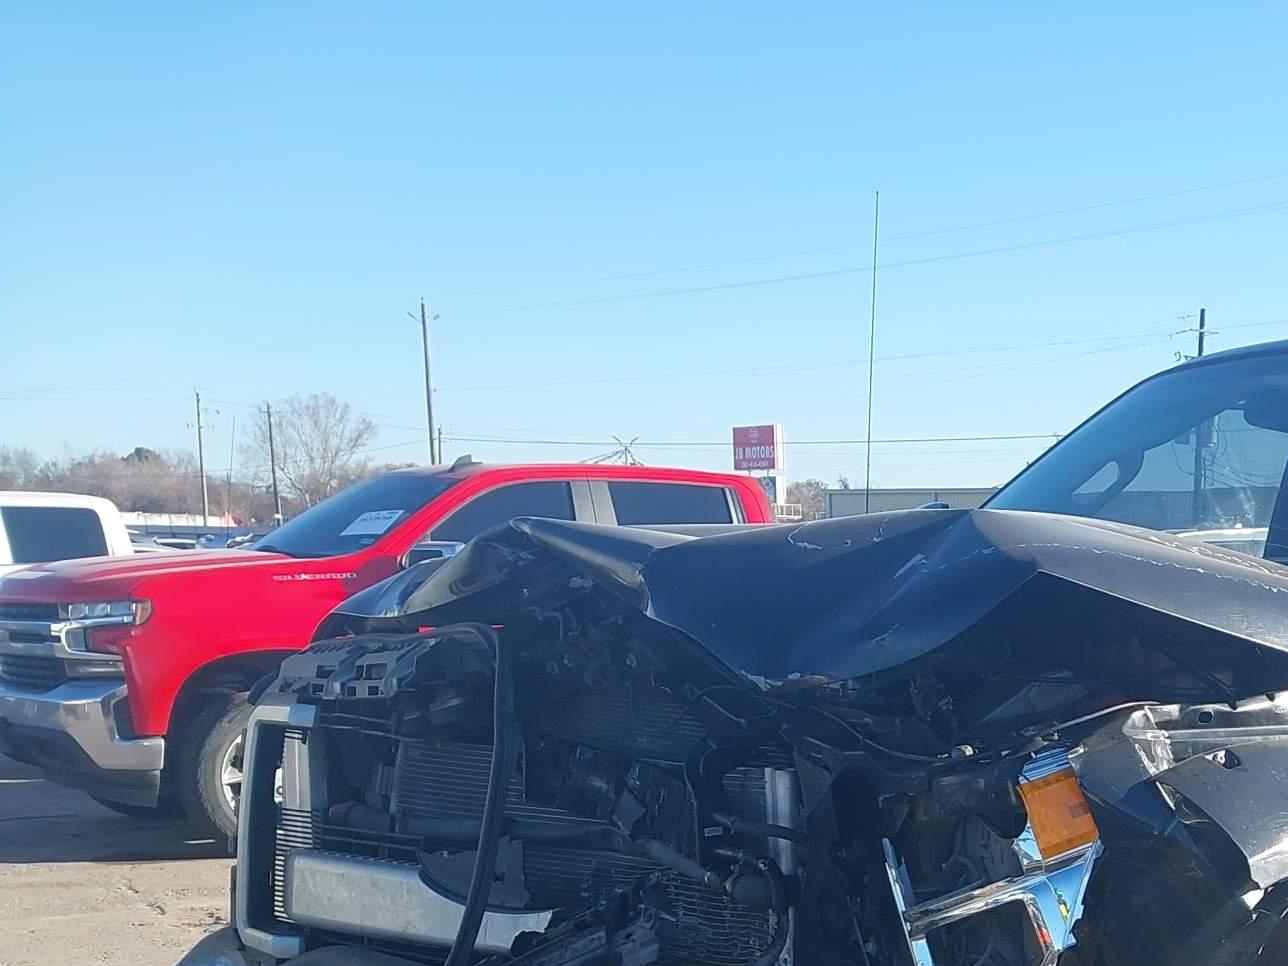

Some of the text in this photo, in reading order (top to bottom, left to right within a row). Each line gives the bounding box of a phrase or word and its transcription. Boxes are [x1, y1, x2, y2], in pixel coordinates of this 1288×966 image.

[735, 445, 774, 460] JB MOTORS
[272, 572, 358, 581] SILVERADO
